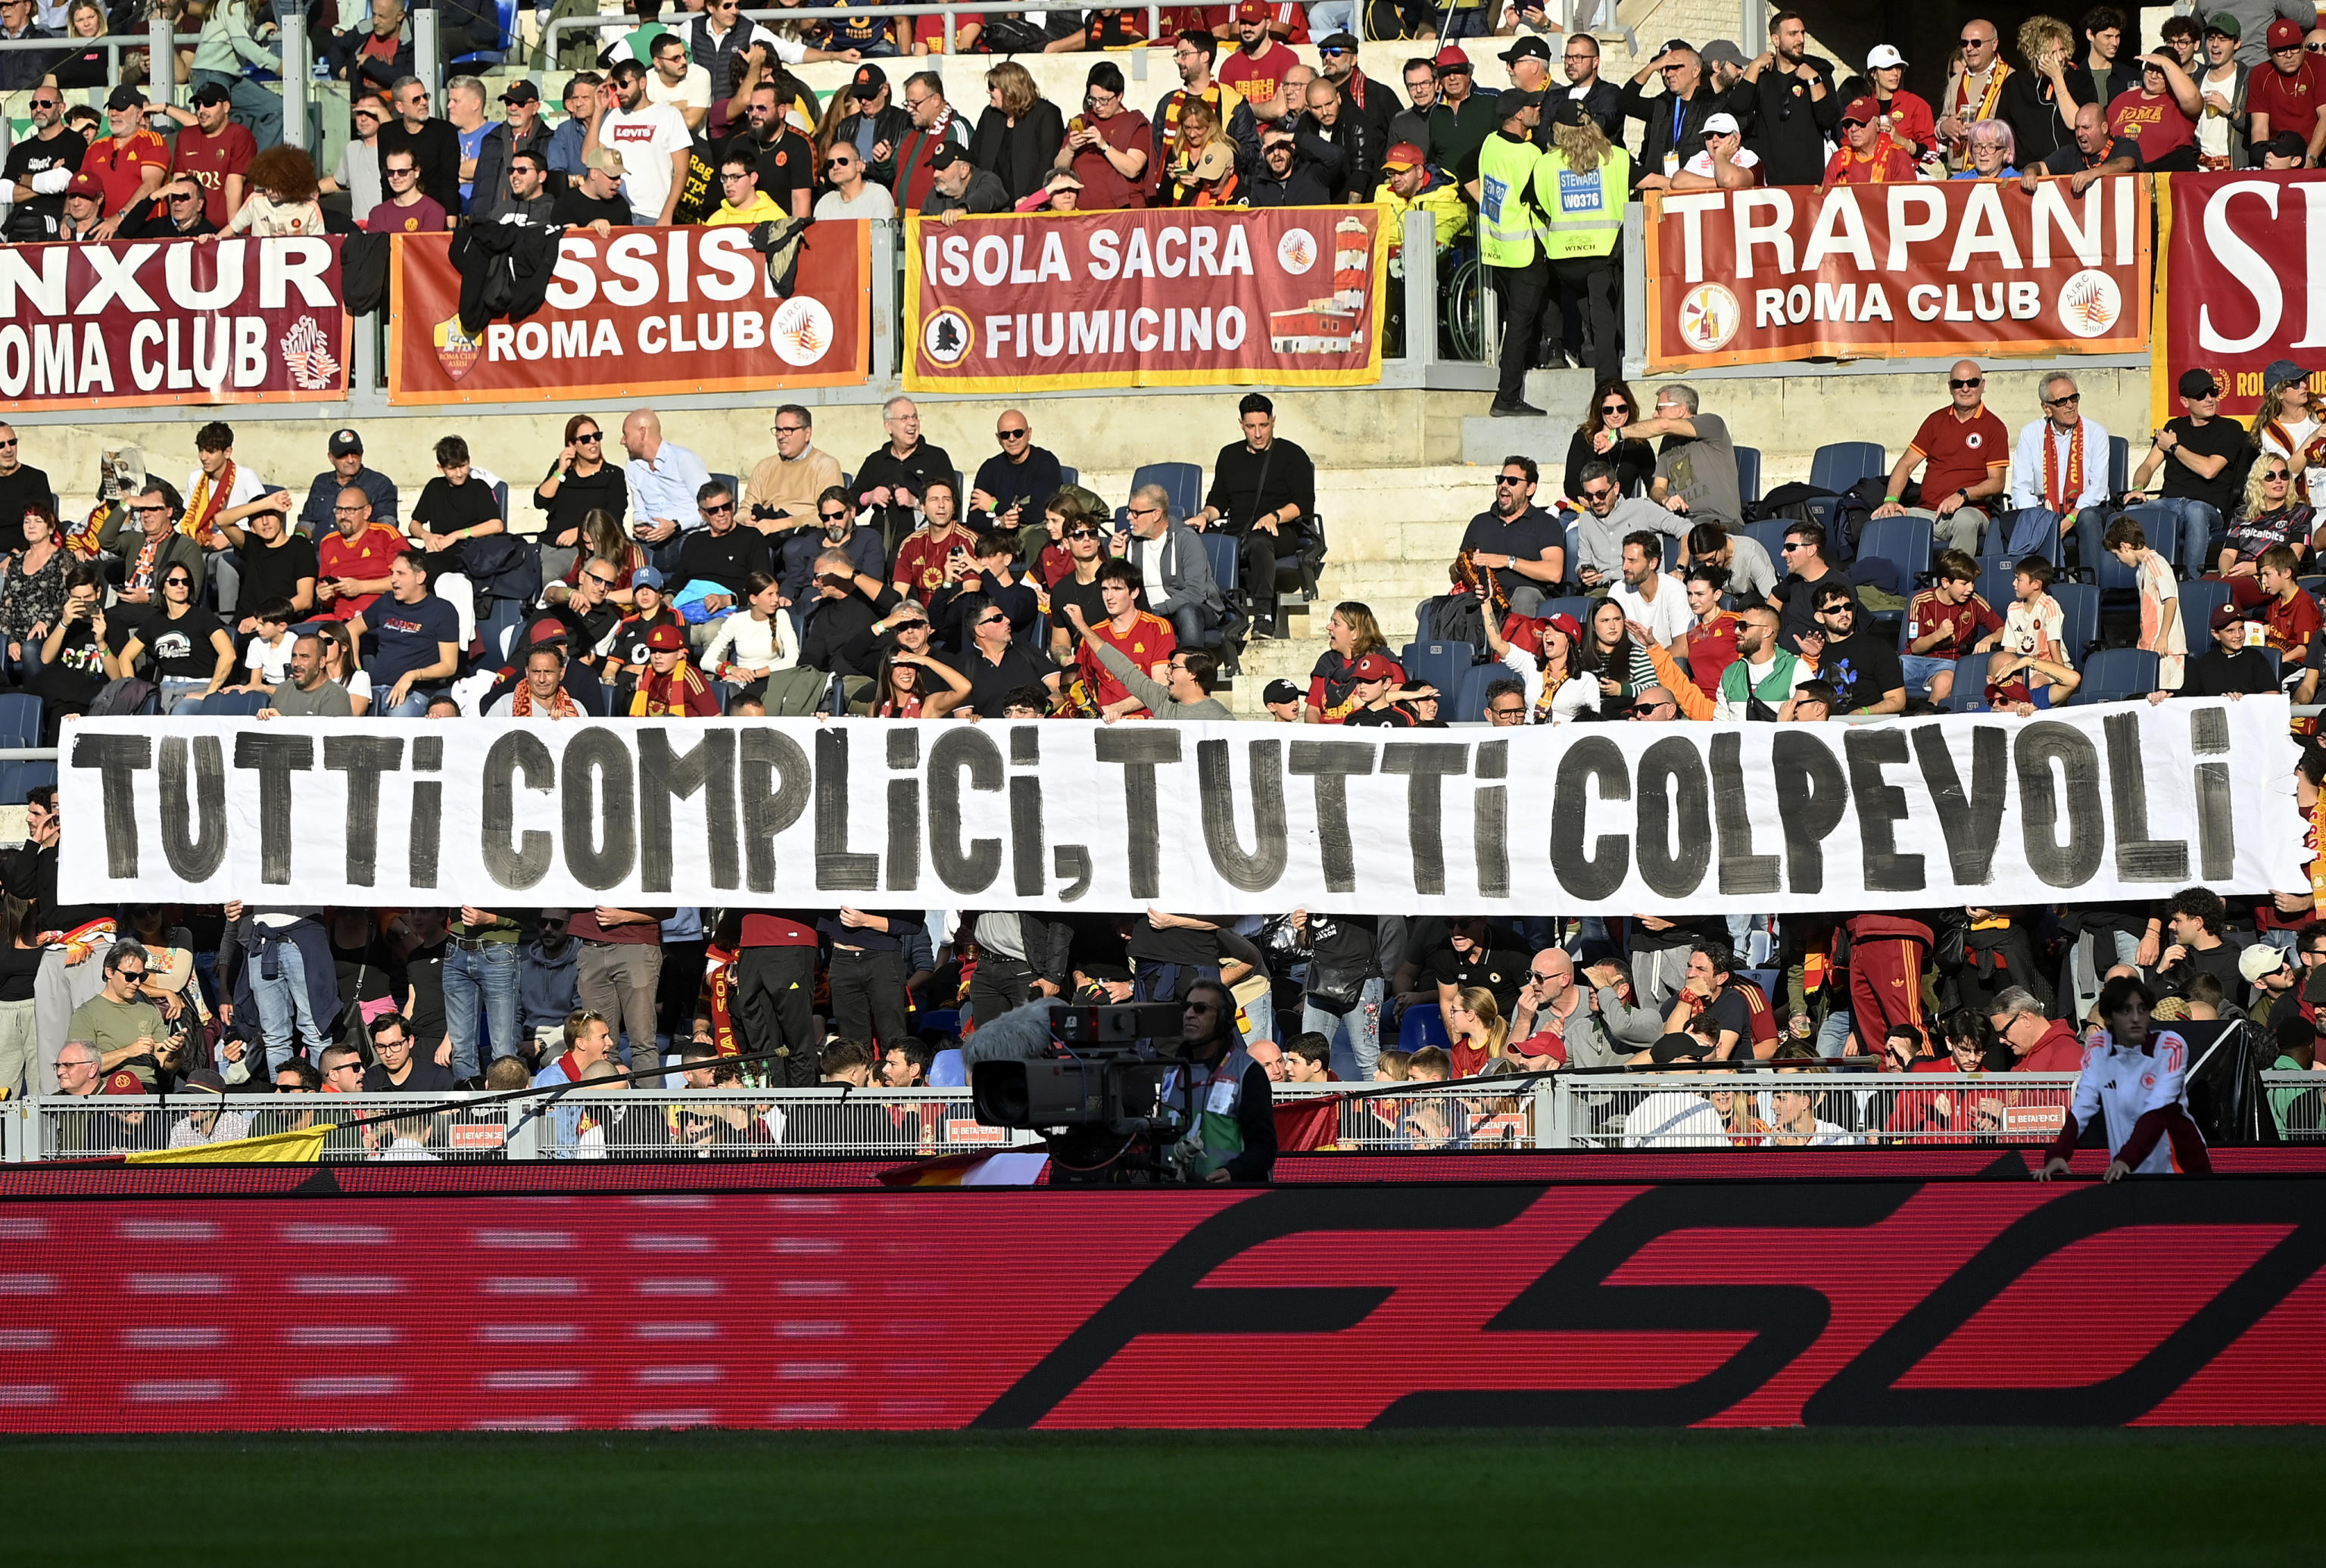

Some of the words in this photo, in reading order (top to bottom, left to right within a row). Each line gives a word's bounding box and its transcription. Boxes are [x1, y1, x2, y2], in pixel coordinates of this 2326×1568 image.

[1561, 172, 1599, 189] STEWARD
[1564, 192, 1599, 209] W0376
[925, 231, 1072, 287] ISOLA
[1087, 224, 1255, 281] SACRA
[1662, 176, 2134, 283] TRAPANI
[544, 226, 780, 310] SSIS
[1756, 282, 1894, 328] ROMA
[1907, 281, 2041, 322] CLUB
[129, 316, 267, 391] CLUB
[488, 319, 624, 362] ROMA
[638, 310, 765, 354] CLUB
[985, 305, 1247, 359] FIUMICINO
